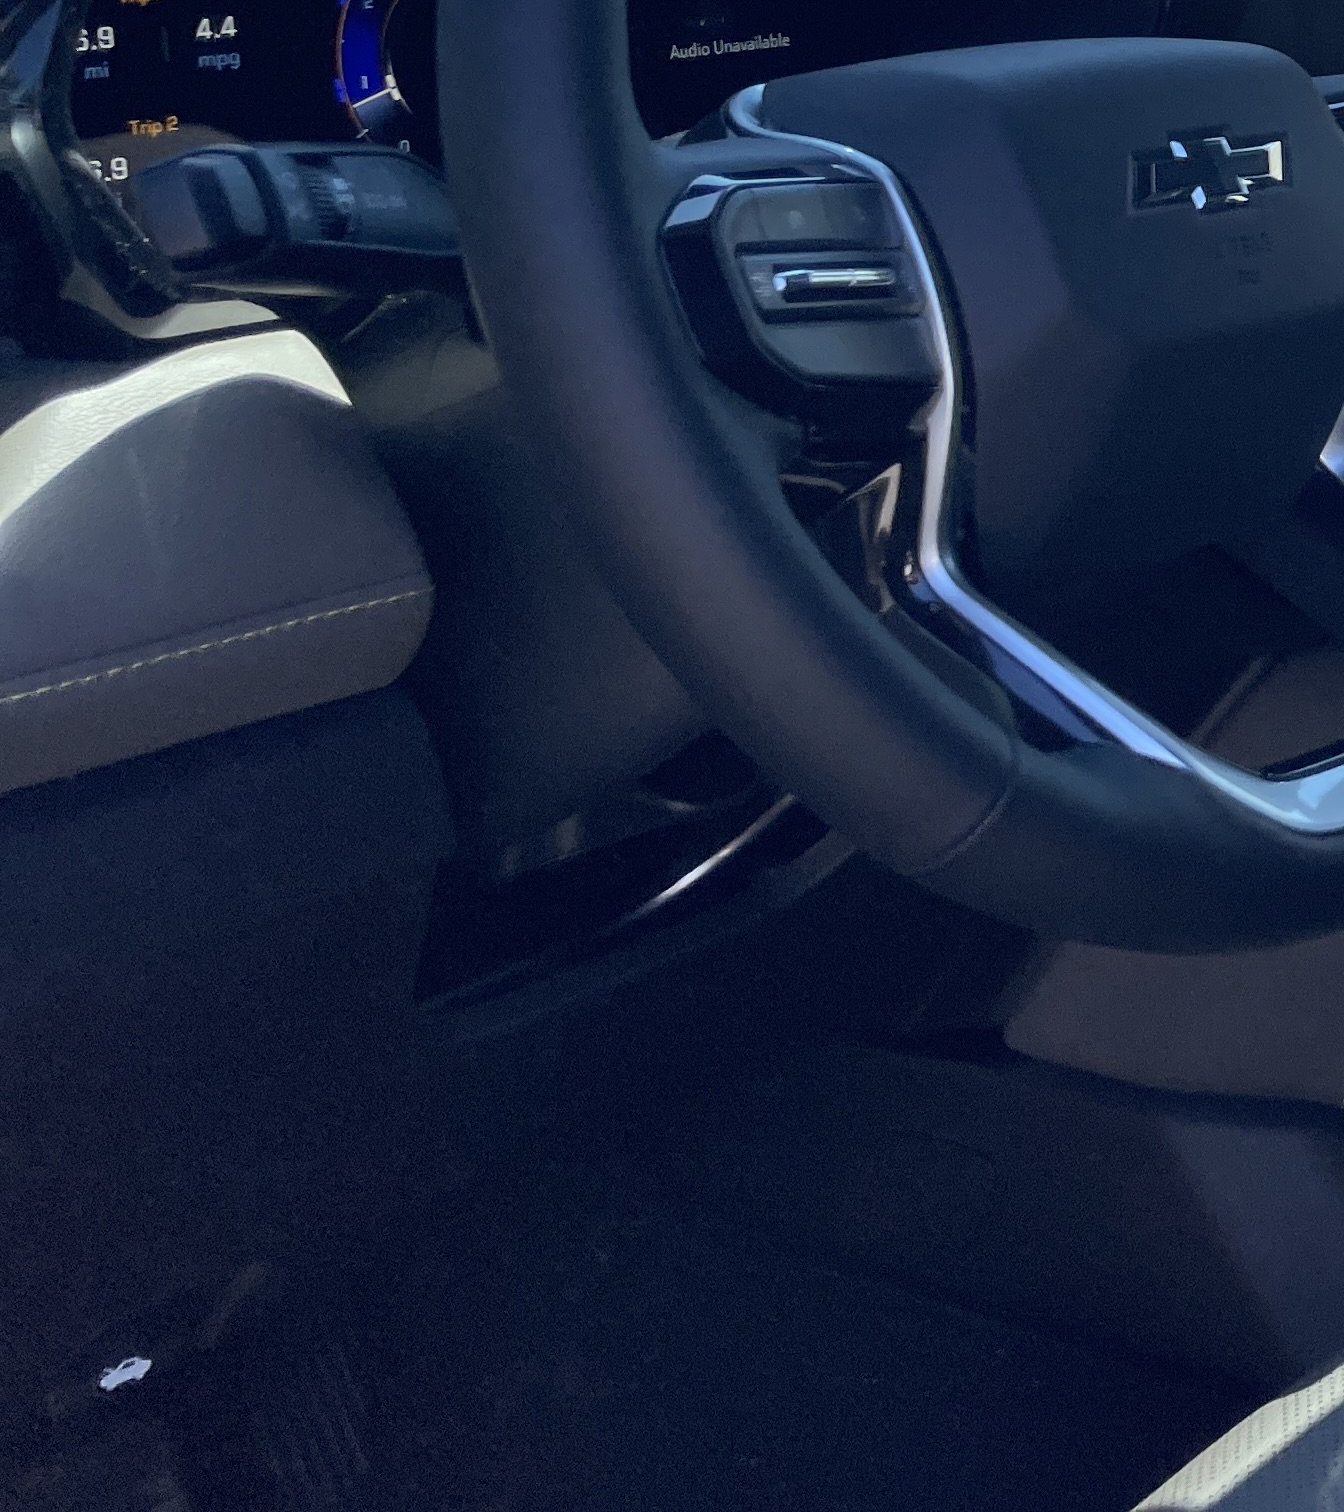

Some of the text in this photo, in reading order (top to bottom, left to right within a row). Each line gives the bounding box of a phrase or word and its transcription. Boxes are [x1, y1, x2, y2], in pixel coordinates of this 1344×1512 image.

[194, 15, 238, 40] 4.4
[669, 33, 791, 60] Audio Unavailable
[84, 61, 110, 80] mi
[197, 51, 241, 71] mpg
[360, 76, 368, 90] 1
[127, 115, 179, 138] Trip 2
